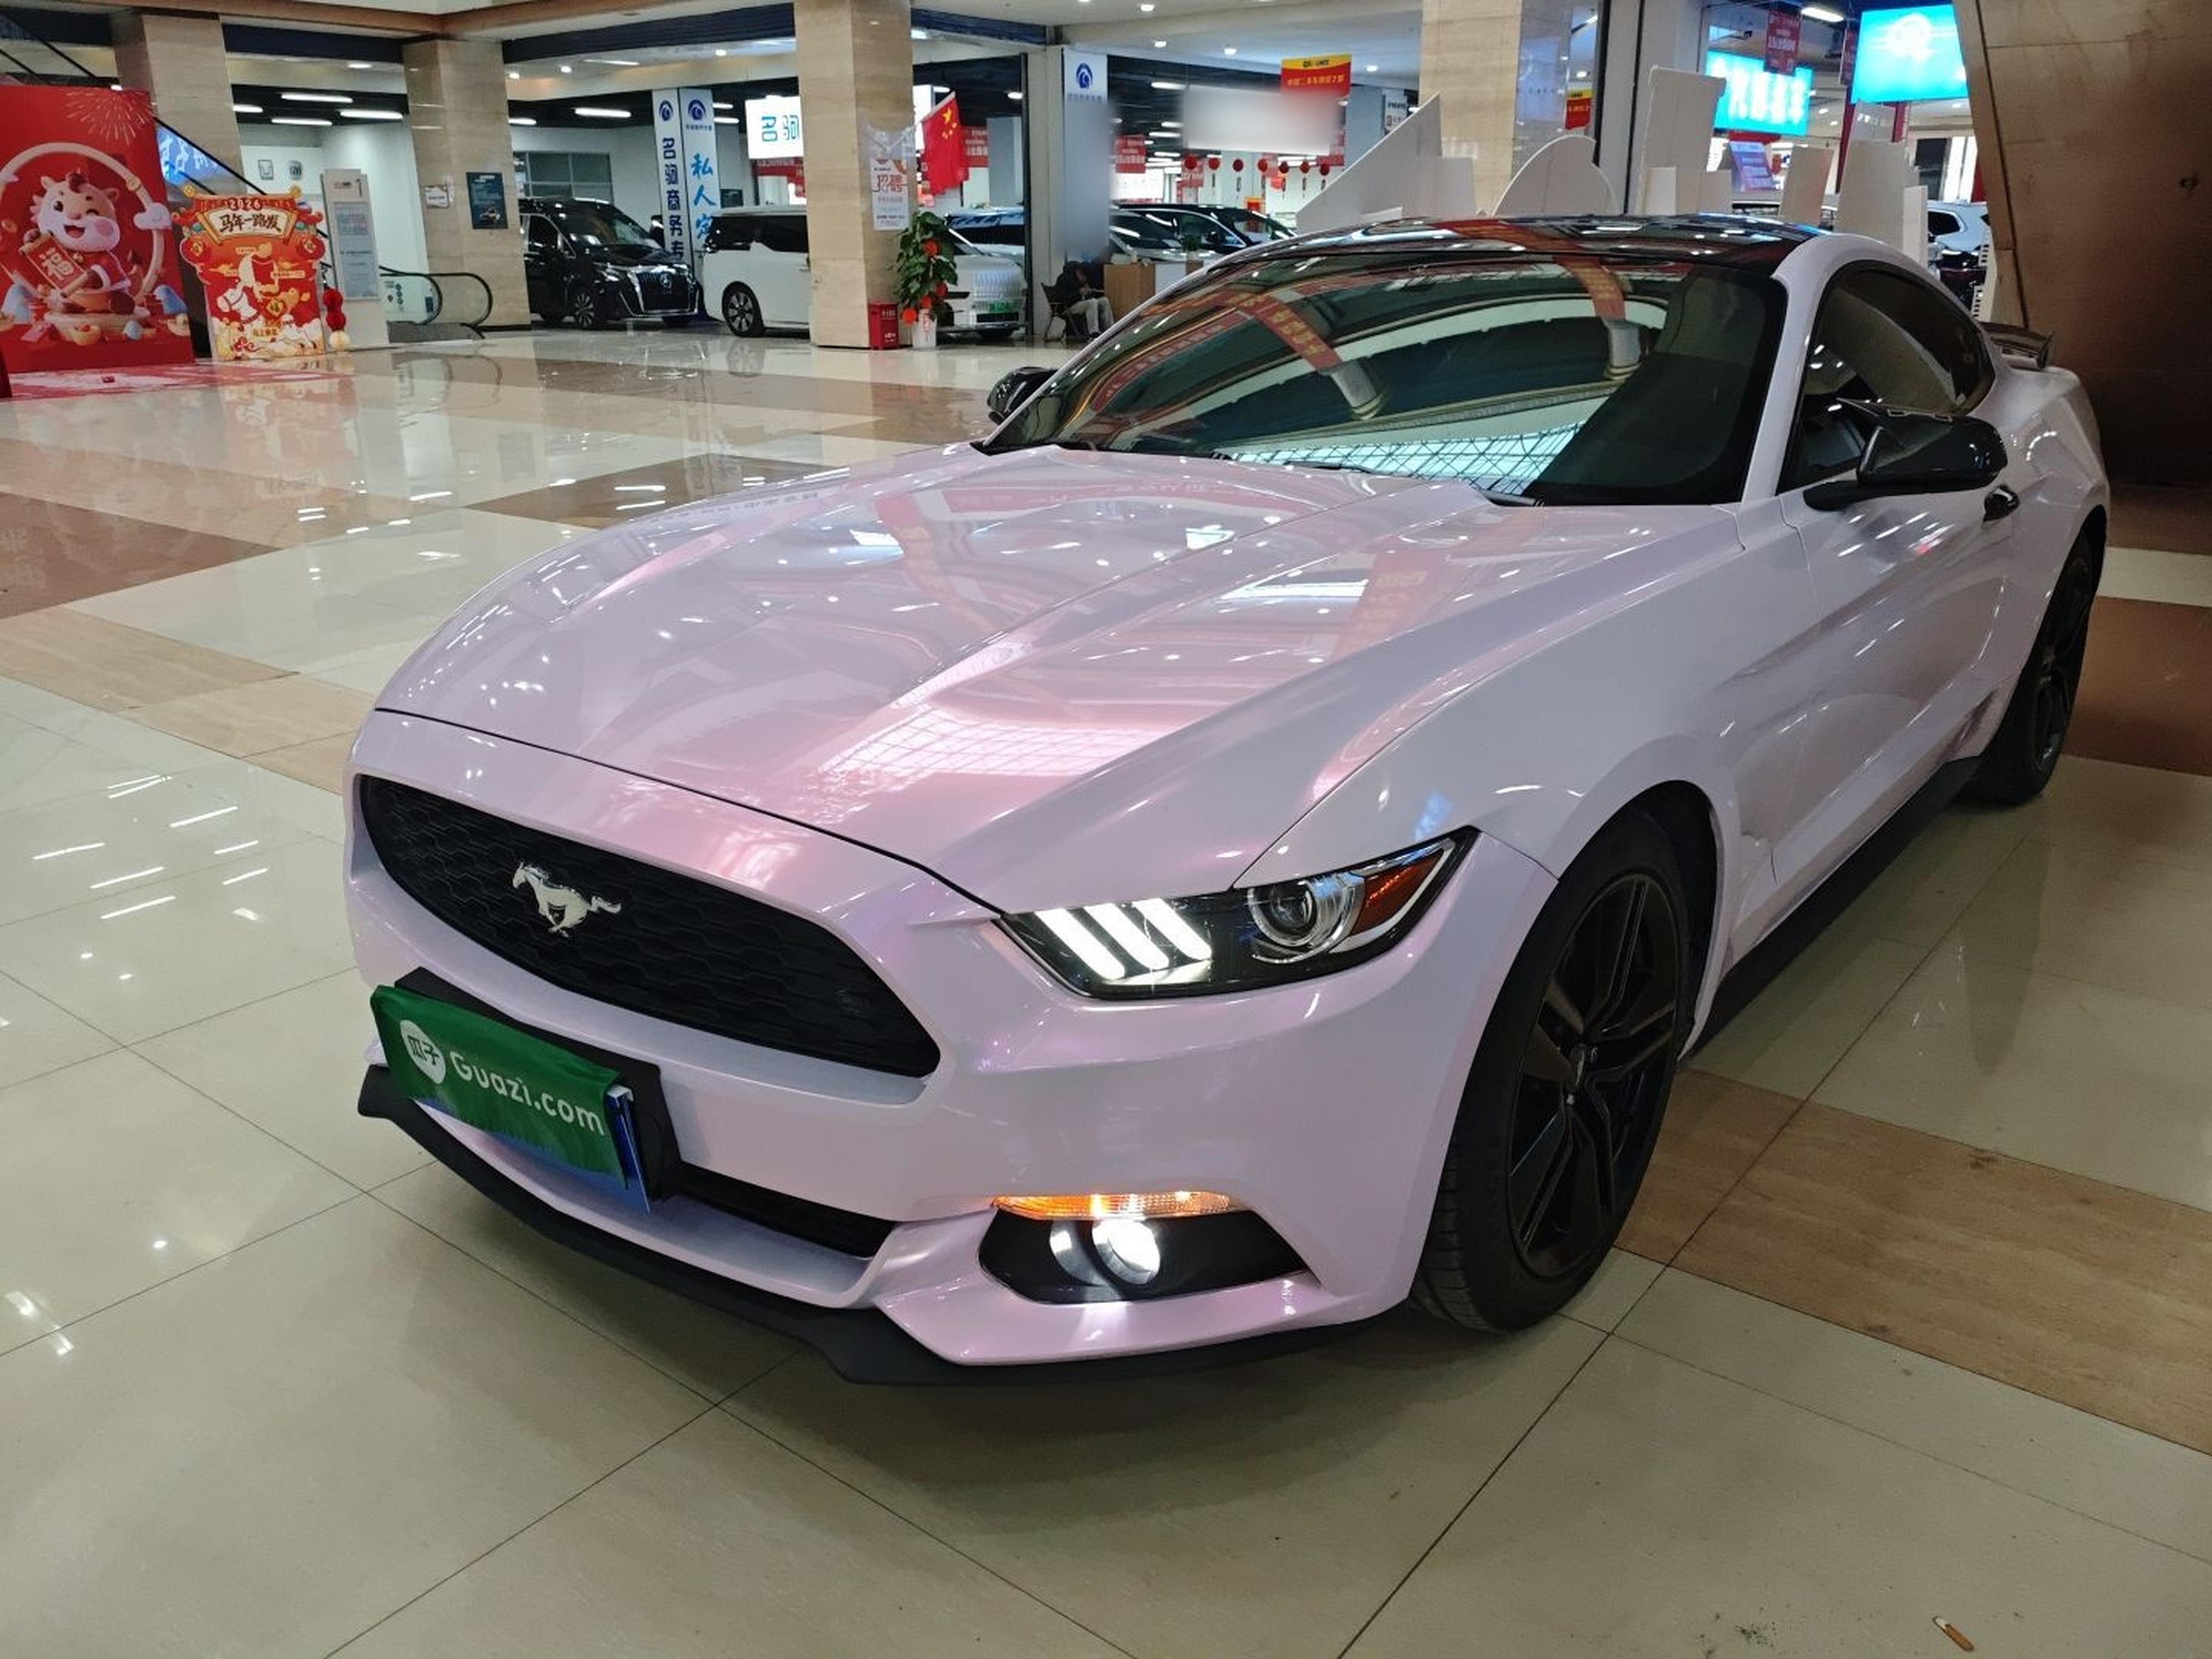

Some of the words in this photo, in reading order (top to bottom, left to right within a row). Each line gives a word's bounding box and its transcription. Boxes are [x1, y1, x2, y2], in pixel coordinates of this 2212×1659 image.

[230, 199, 260, 208] 2026
[219, 213, 282, 232] 马年一路发
[39, 248, 74, 281] 福
[450, 1051, 604, 1135] Guazi.com
